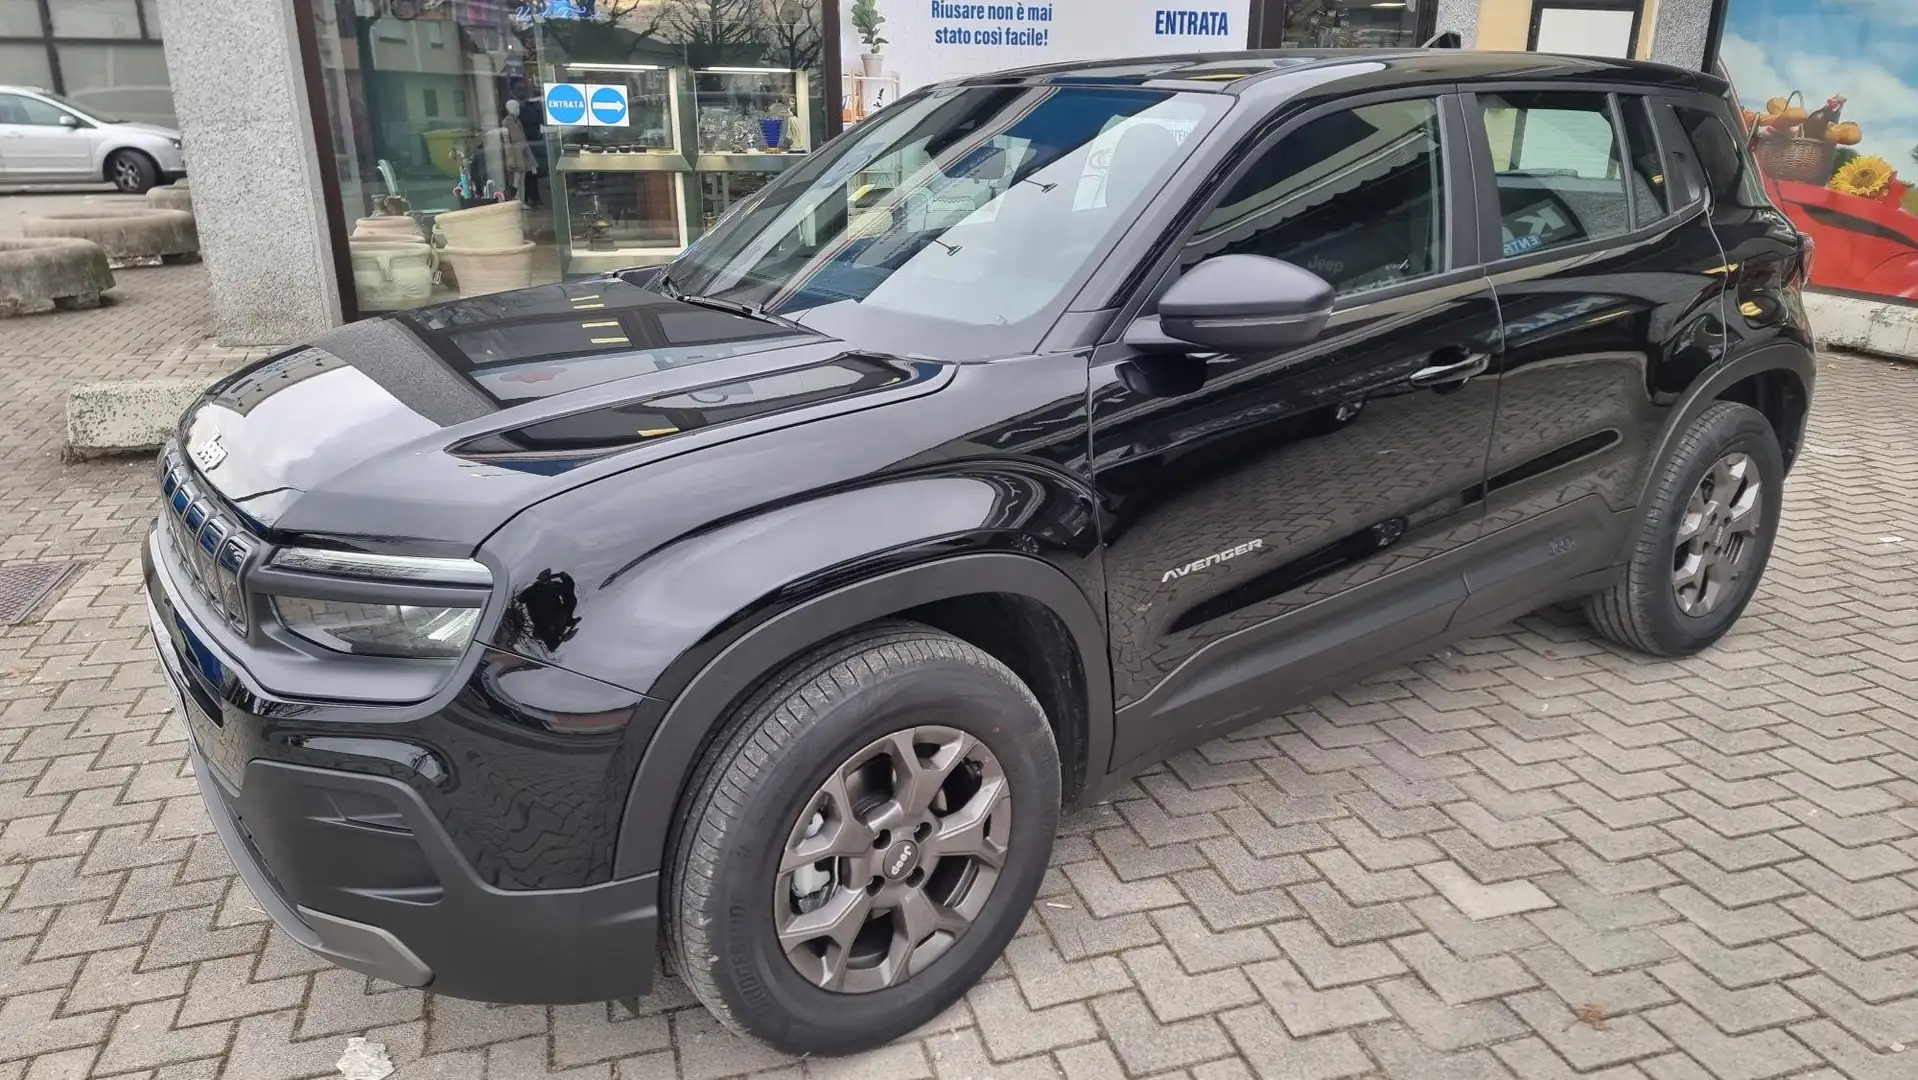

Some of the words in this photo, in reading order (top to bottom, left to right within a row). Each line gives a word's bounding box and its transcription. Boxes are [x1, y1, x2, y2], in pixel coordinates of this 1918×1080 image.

[931, 0, 985, 19] Riusare
[987, 4, 1014, 20] non
[1016, 2, 1025, 20] è
[1027, 3, 1053, 21] mai
[1155, 10, 1229, 35] ENTRATA
[935, 27, 972, 44] stato
[974, 26, 1002, 45] così
[1005, 27, 1049, 46] facile!
[548, 100, 584, 108] ENTRATA
[1308, 254, 1344, 276] Jeep
[1161, 538, 1263, 583] AVENGER
[890, 844, 912, 876] Jeep
